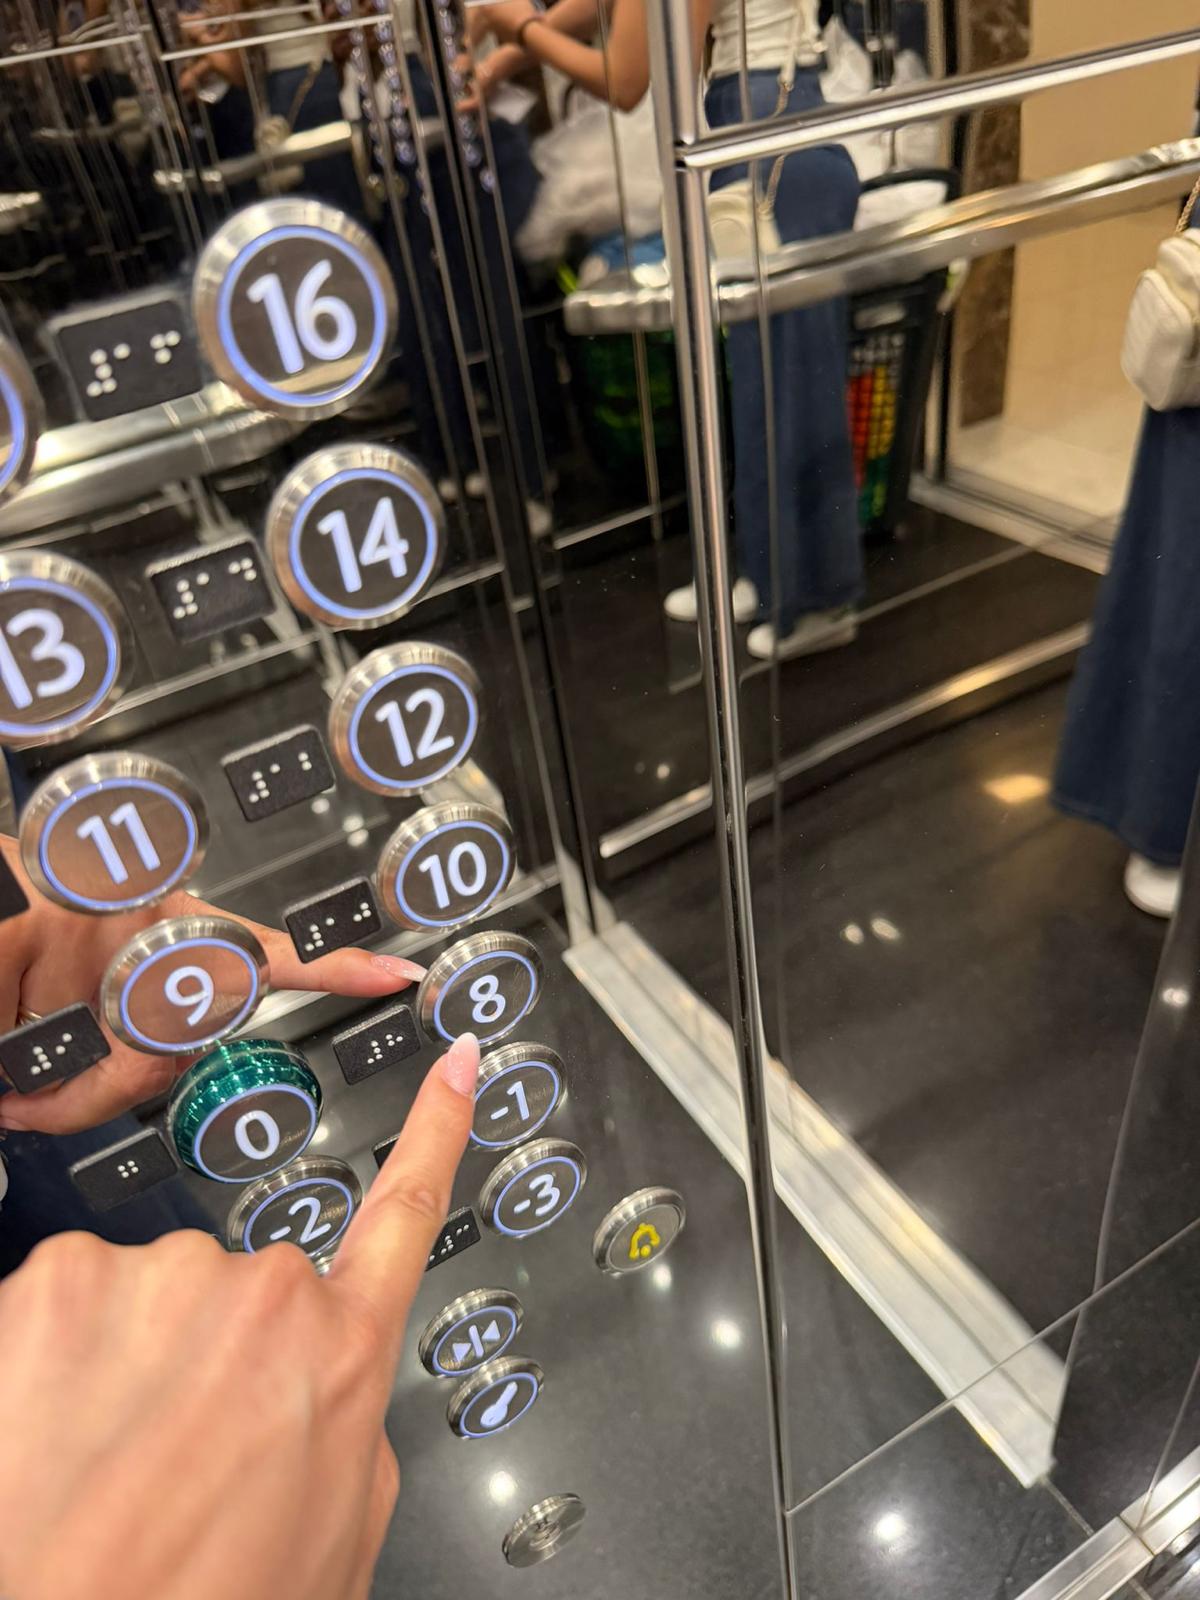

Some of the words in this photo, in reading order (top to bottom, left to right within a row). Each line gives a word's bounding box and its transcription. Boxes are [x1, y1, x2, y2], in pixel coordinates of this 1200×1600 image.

[248, 260, 356, 373] 16
[317, 498, 408, 592] 14
[375, 689, 454, 766] 12
[77, 802, 160, 884] 11
[419, 841, 486, 908] 10
[165, 966, 214, 1026] 9
[469, 974, 506, 1023] 8
[490, 1081, 529, 1121] -1
[234, 1110, 280, 1160] 0
[270, 1197, 332, 1243] -2
[513, 1173, 560, 1217] -3
